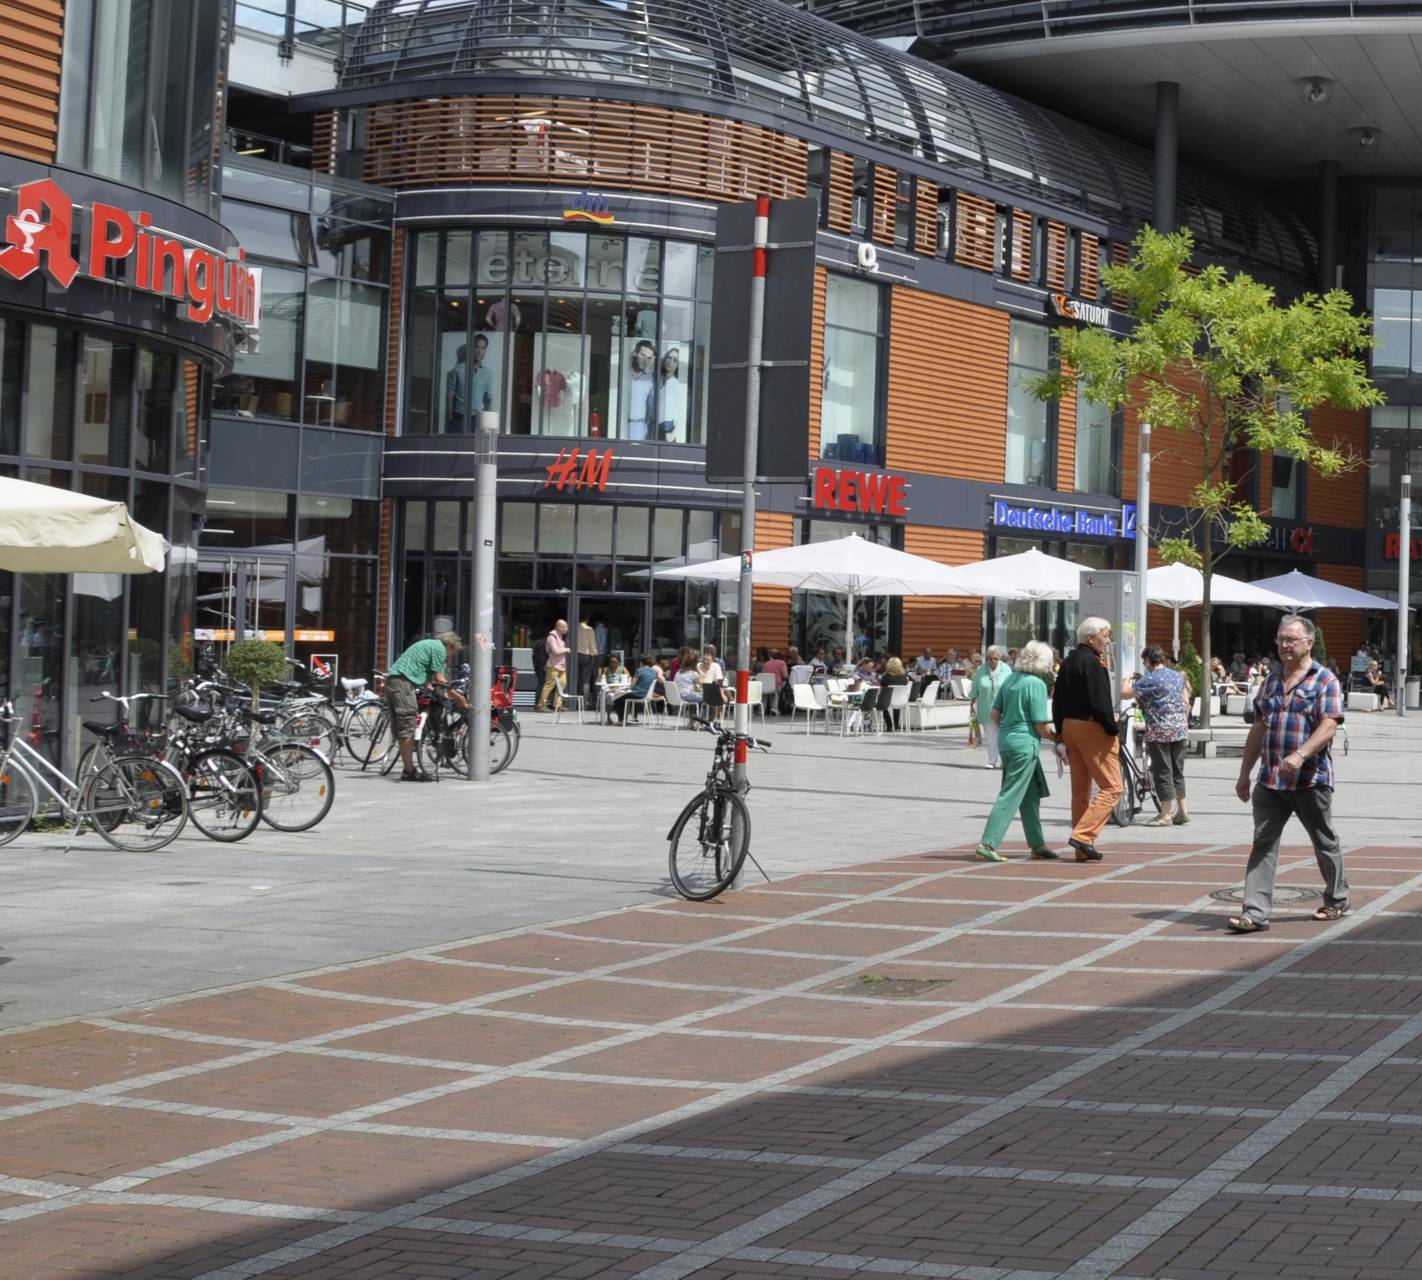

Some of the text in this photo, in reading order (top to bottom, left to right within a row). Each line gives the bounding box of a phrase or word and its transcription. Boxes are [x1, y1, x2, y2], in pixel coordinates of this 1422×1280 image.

[571, 190, 609, 212] dm
[89, 201, 256, 326] Pinguin
[1073, 301, 1109, 326] SATURN
[544, 447, 614, 493] H&M
[815, 467, 908, 517] REWE
[994, 501, 1116, 537] Deutsche Bank
